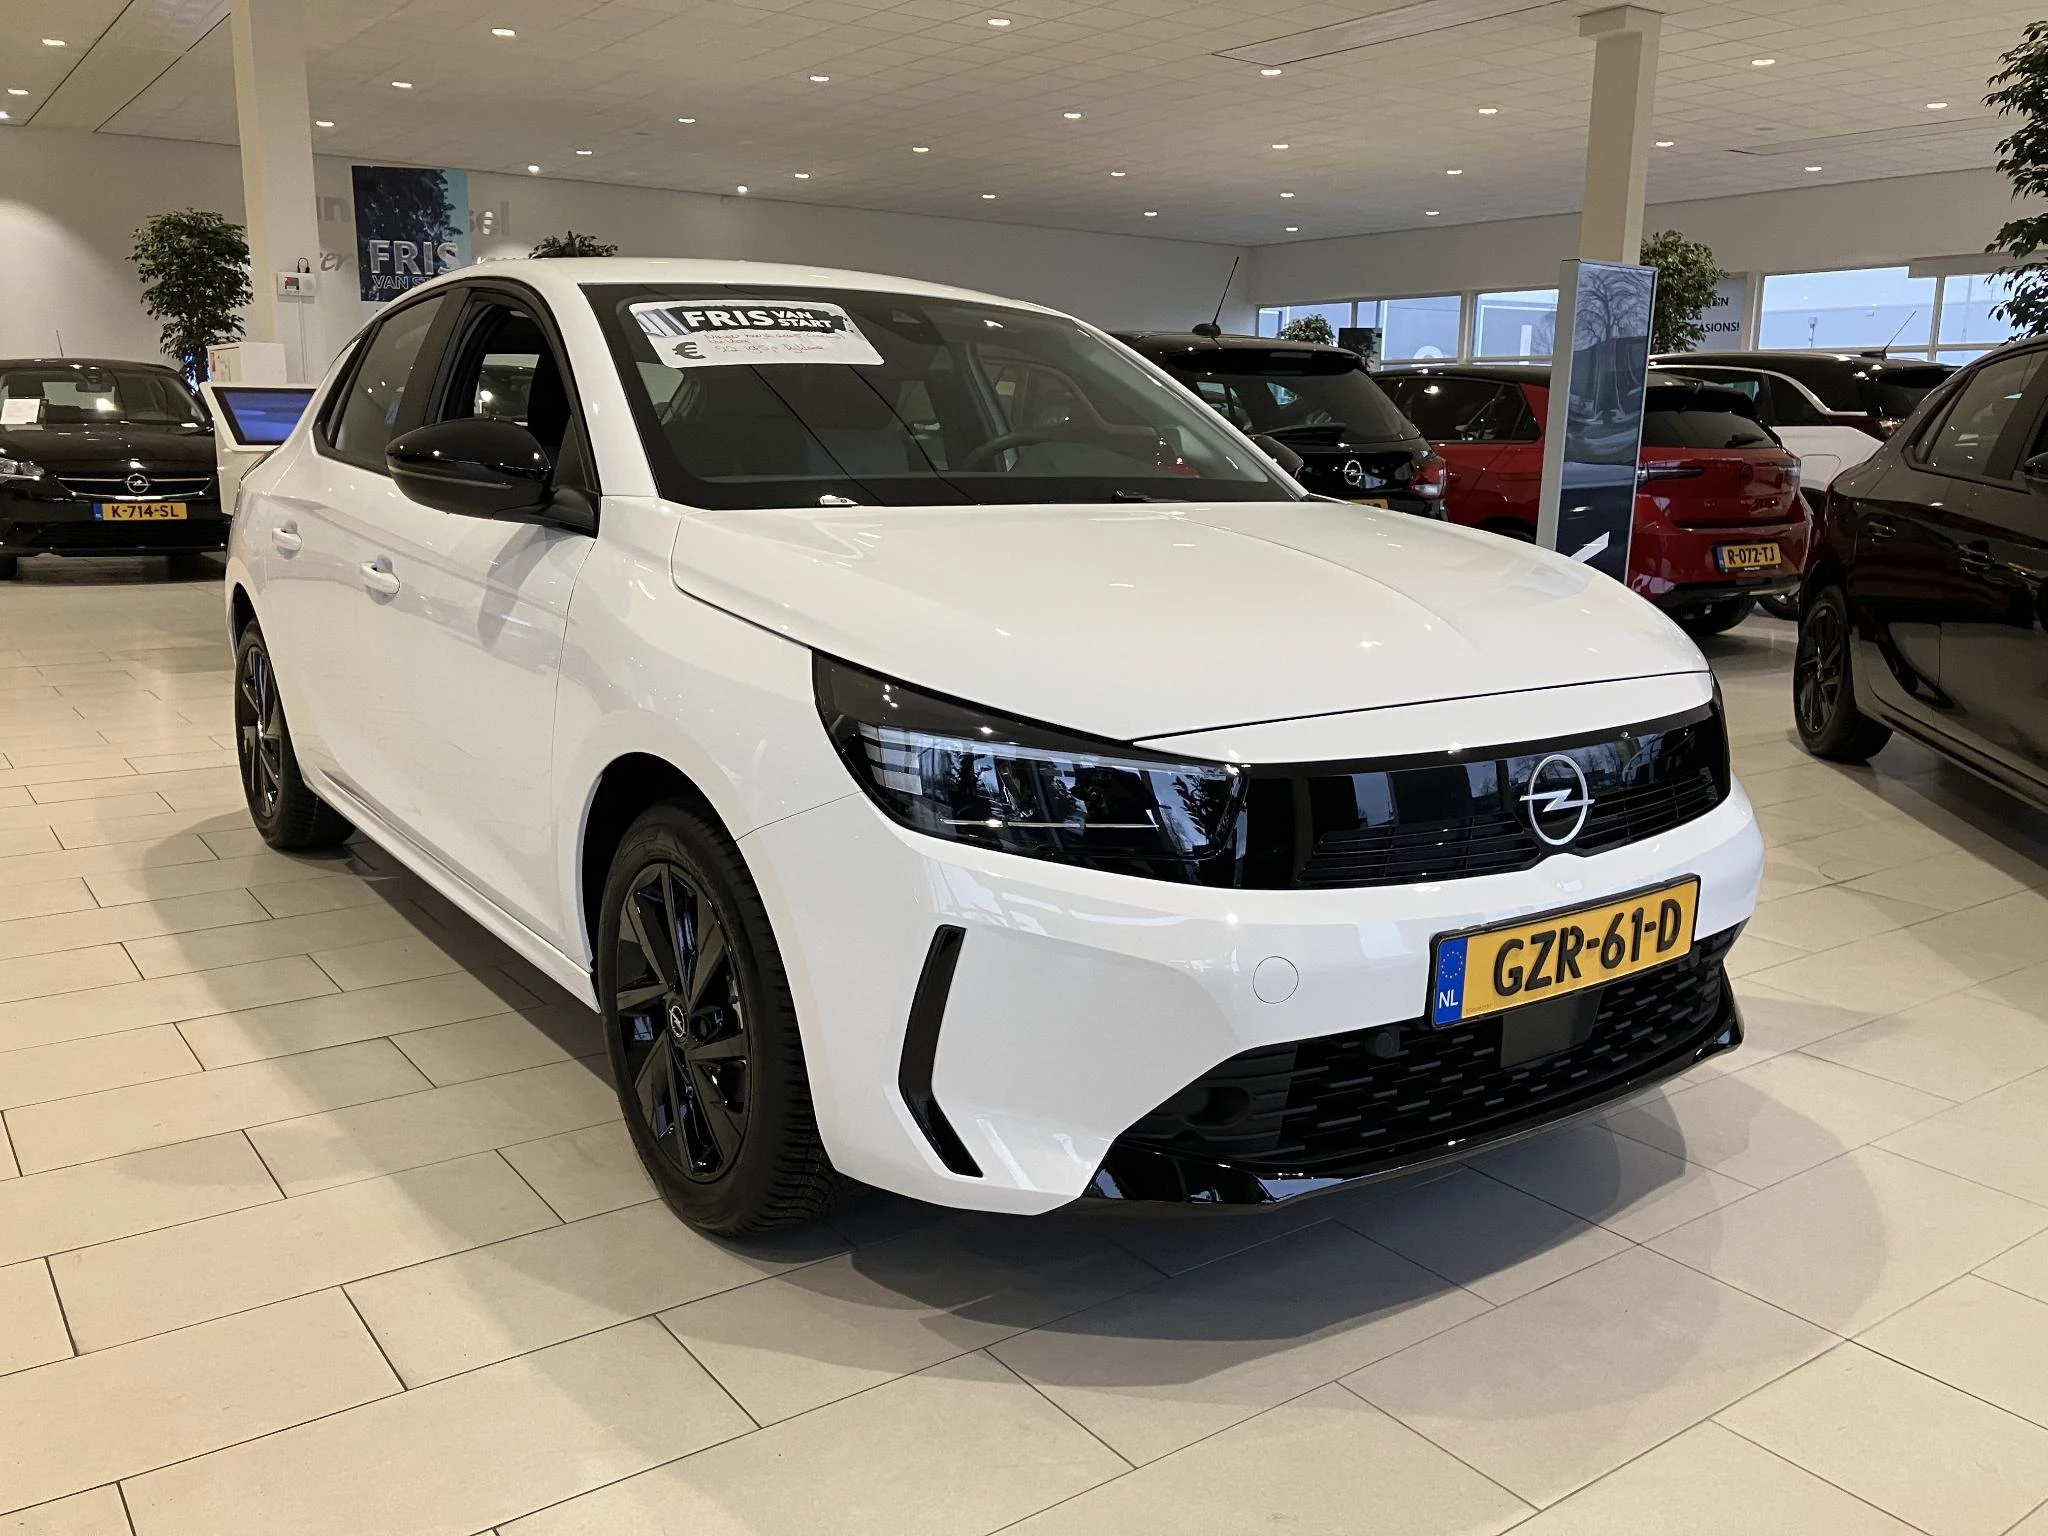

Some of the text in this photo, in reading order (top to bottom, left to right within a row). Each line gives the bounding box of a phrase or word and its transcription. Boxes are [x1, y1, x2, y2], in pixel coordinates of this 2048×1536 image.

[369, 239, 460, 275] FRIS
[371, 275, 409, 290] VAN
[681, 310, 775, 328] FRIS
[770, 310, 813, 319] VAN
[779, 318, 832, 329] START
[671, 341, 706, 360] €
[112, 505, 179, 518] K-714-SL
[1727, 546, 1775, 565] R-072-TJ
[1493, 898, 1682, 997] GZR-61-D
[1438, 989, 1459, 1009] NL
